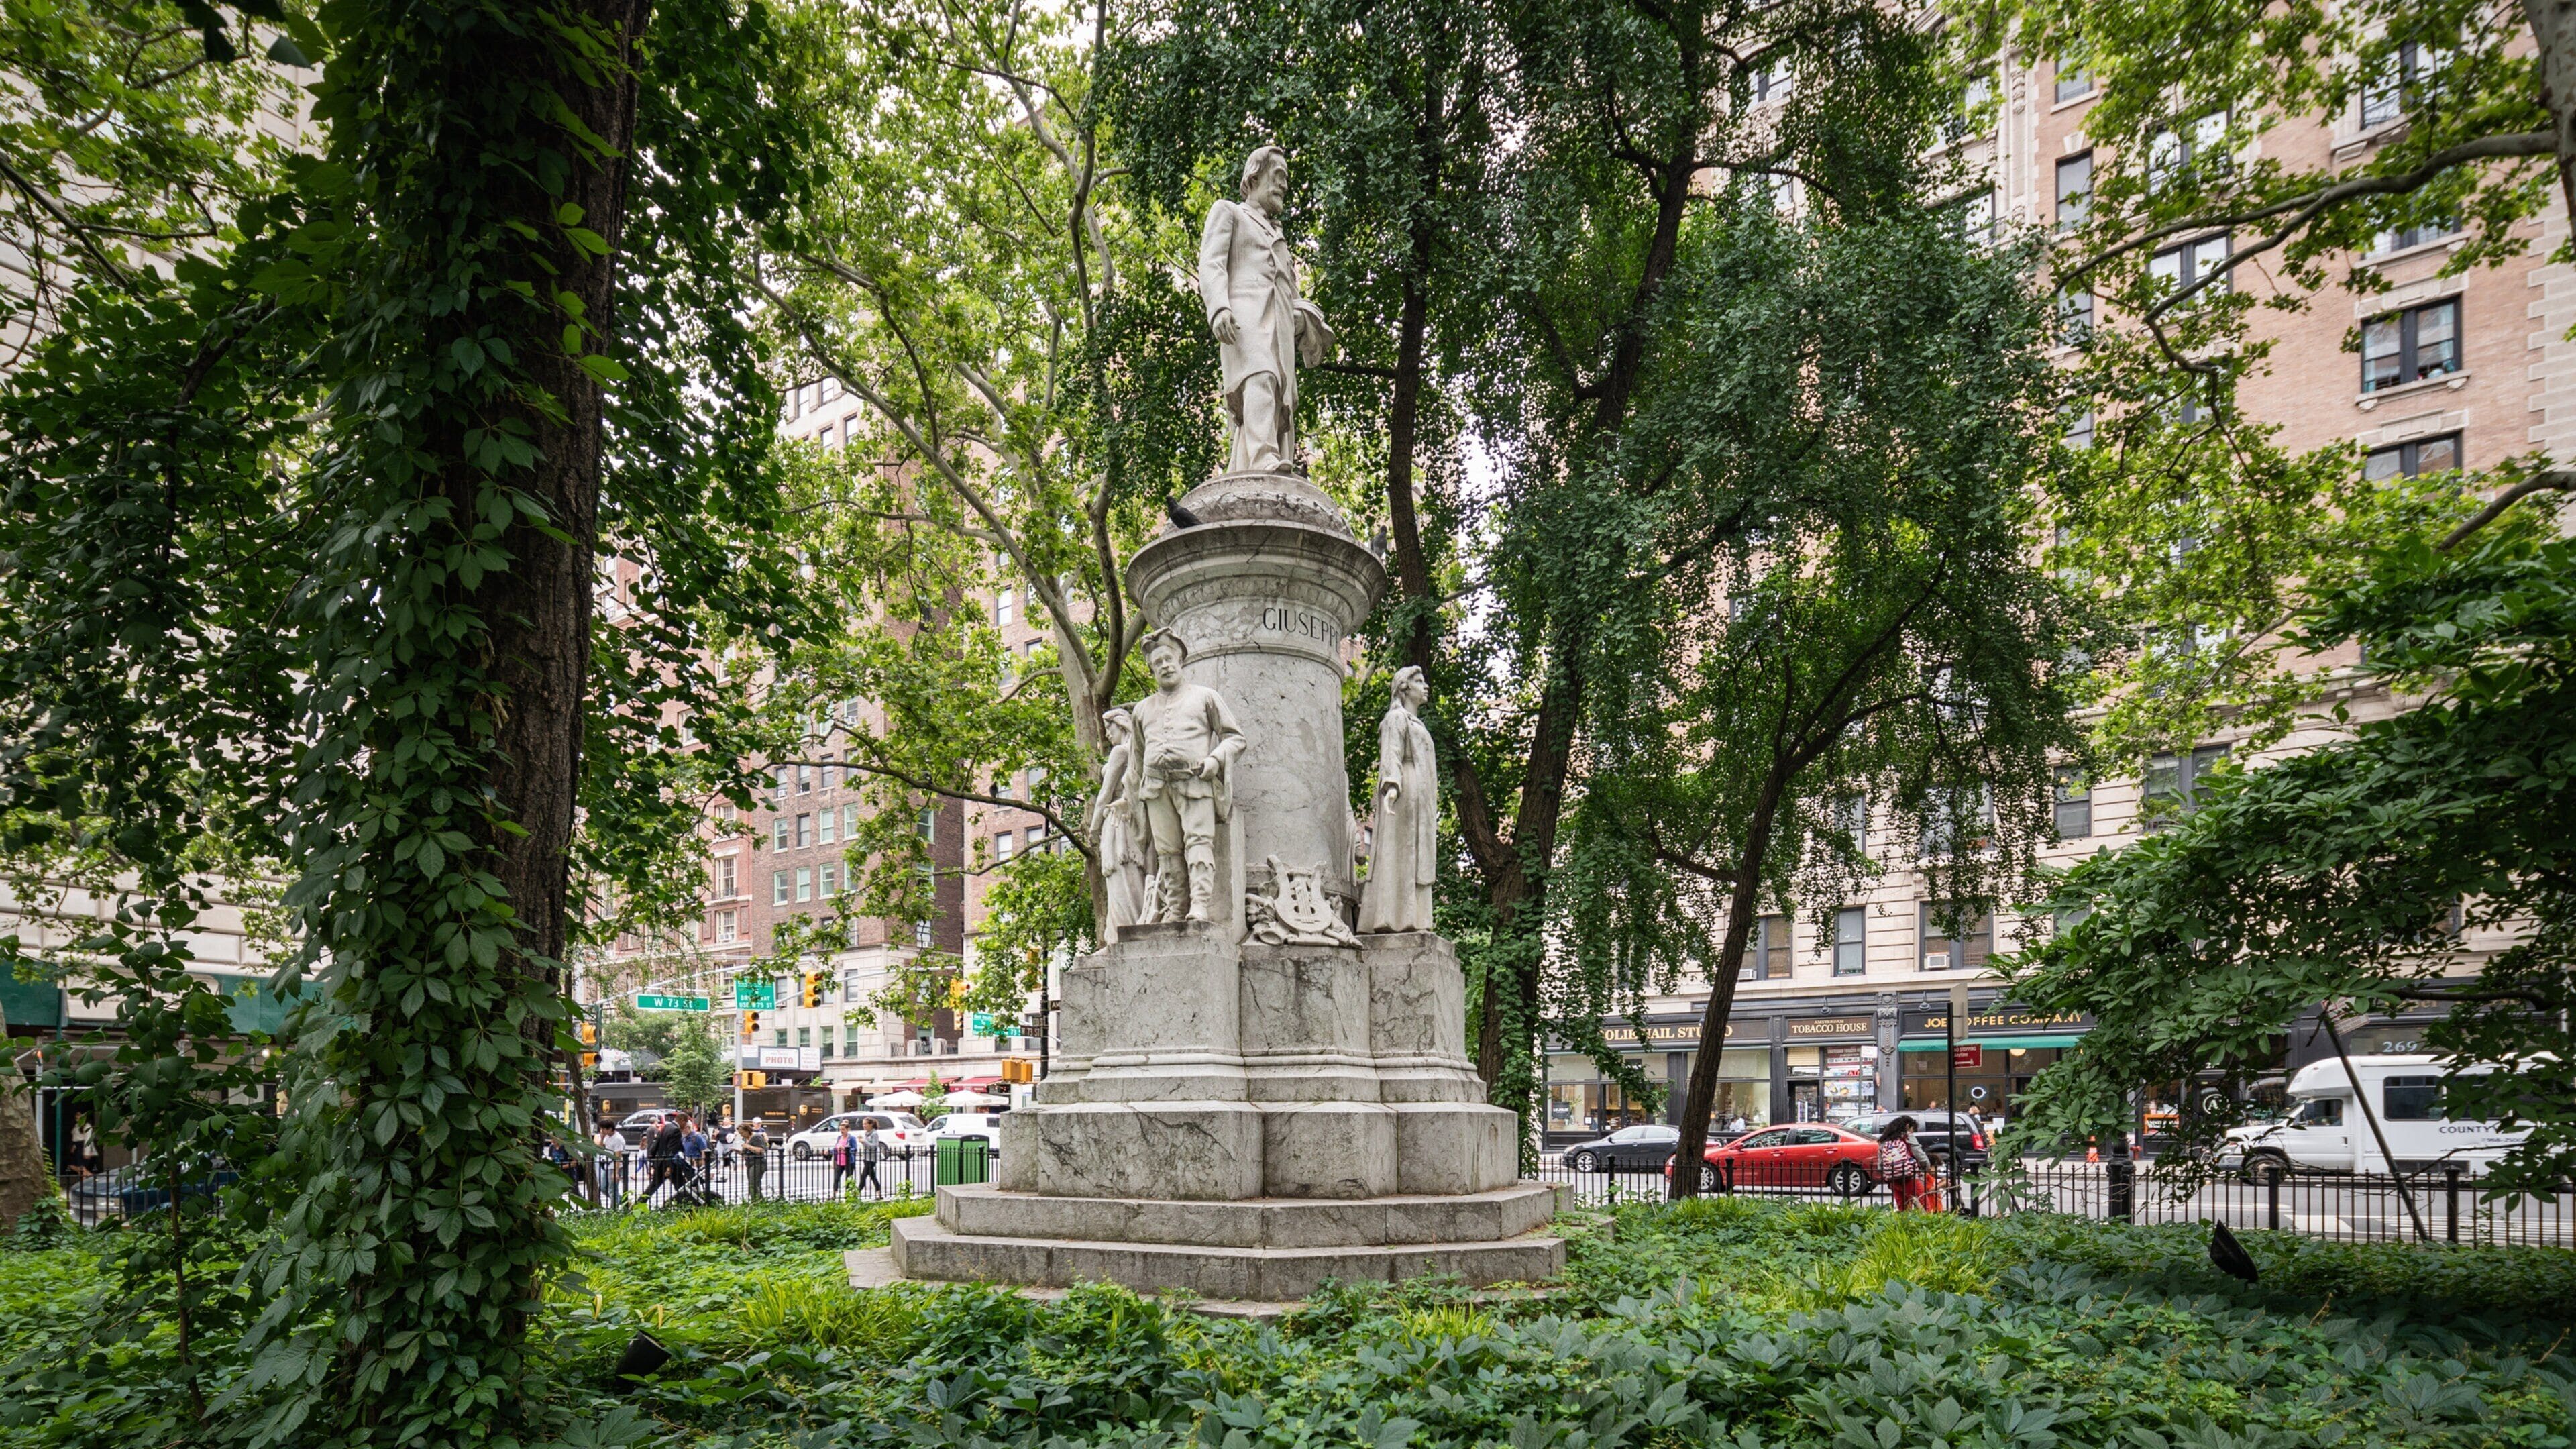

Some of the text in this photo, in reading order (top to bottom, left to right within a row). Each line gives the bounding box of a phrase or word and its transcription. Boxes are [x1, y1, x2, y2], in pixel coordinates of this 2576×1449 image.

[654, 998, 663, 1007] W
[667, 998, 679, 1008] 73
[1924, 1018, 1947, 1028] JOE
[1967, 1016, 2004, 1026] FFEE
[1027, 1028, 1033, 1036] 73
[1599, 1028, 1638, 1040] OLIE
[1678, 1025, 1733, 1038] STUO
[1792, 1023, 1867, 1033] TOBACCO HOUSE
[2383, 1041, 2417, 1052] 269
